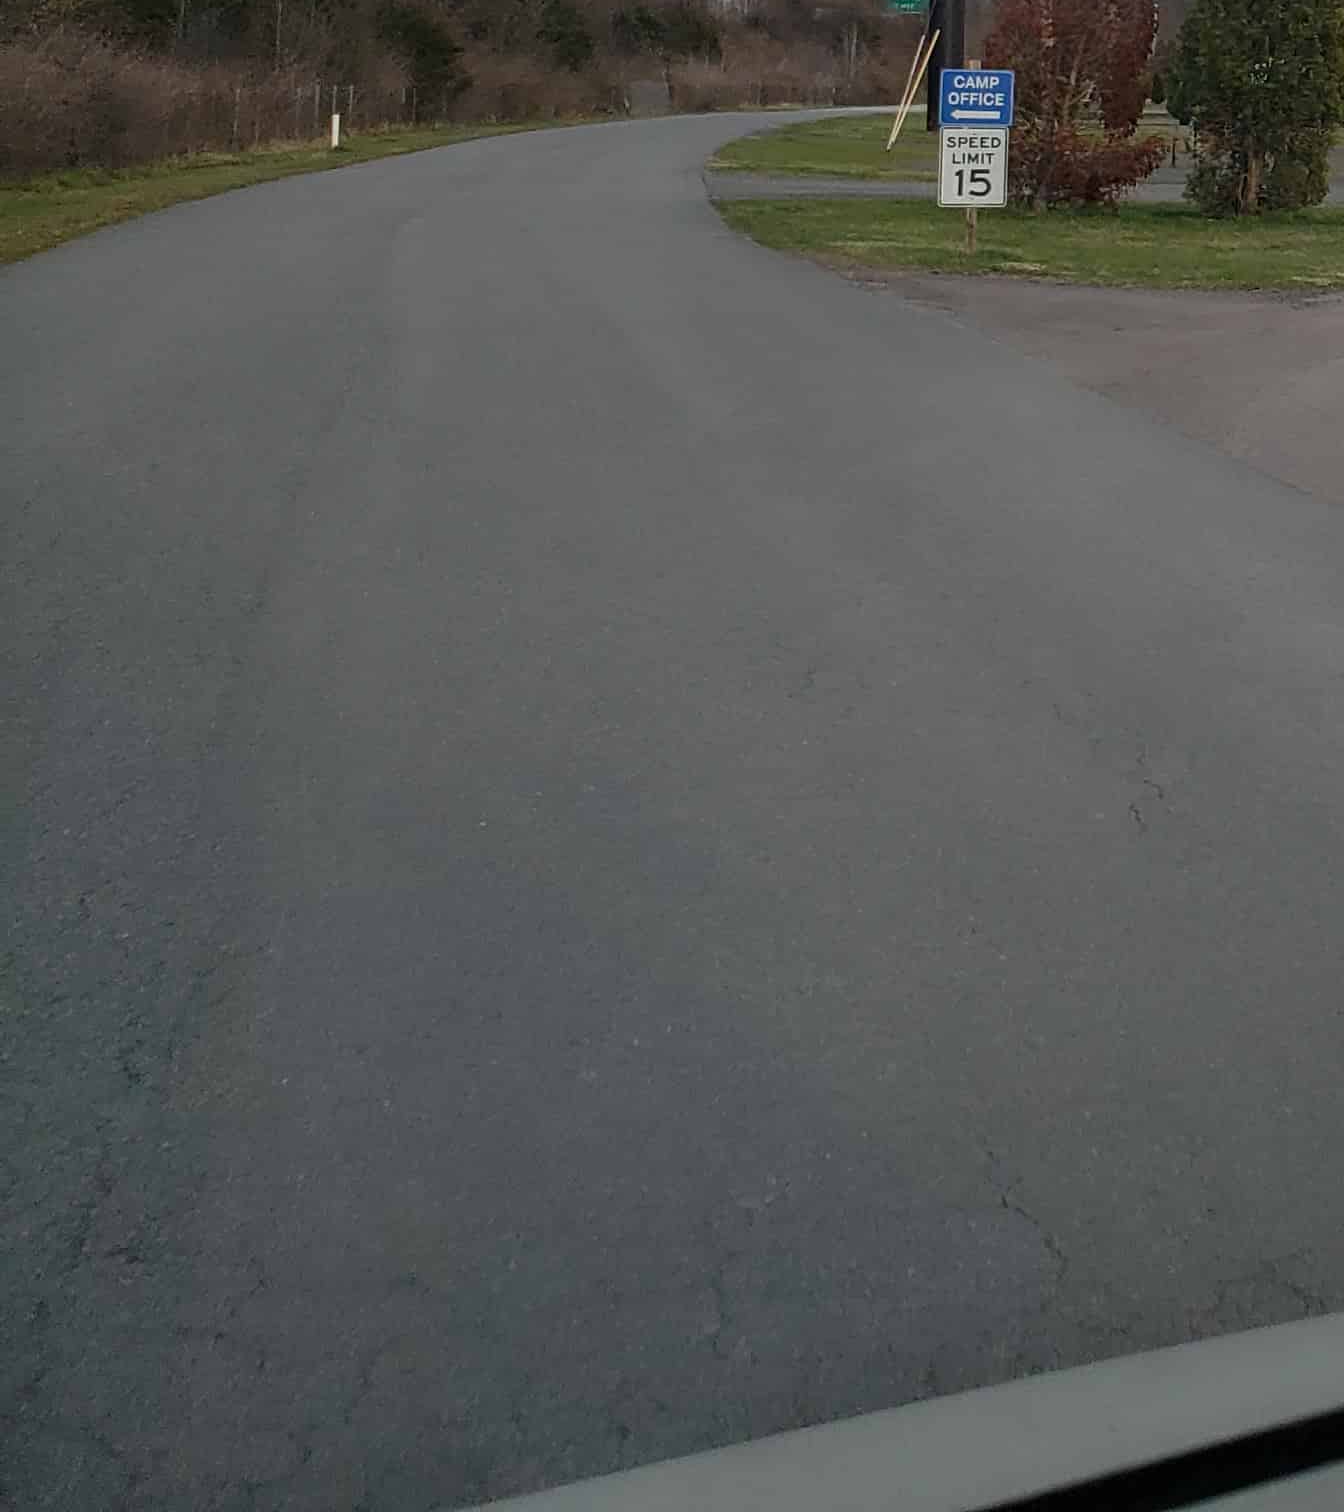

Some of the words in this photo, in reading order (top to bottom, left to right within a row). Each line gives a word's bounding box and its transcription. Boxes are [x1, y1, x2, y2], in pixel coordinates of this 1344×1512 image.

[953, 75, 1000, 89] CAMP
[948, 92, 1006, 106] OFFICE
[946, 136, 1002, 148] SPEED
[952, 153, 995, 165] LIMIT
[954, 169, 992, 197] 15
